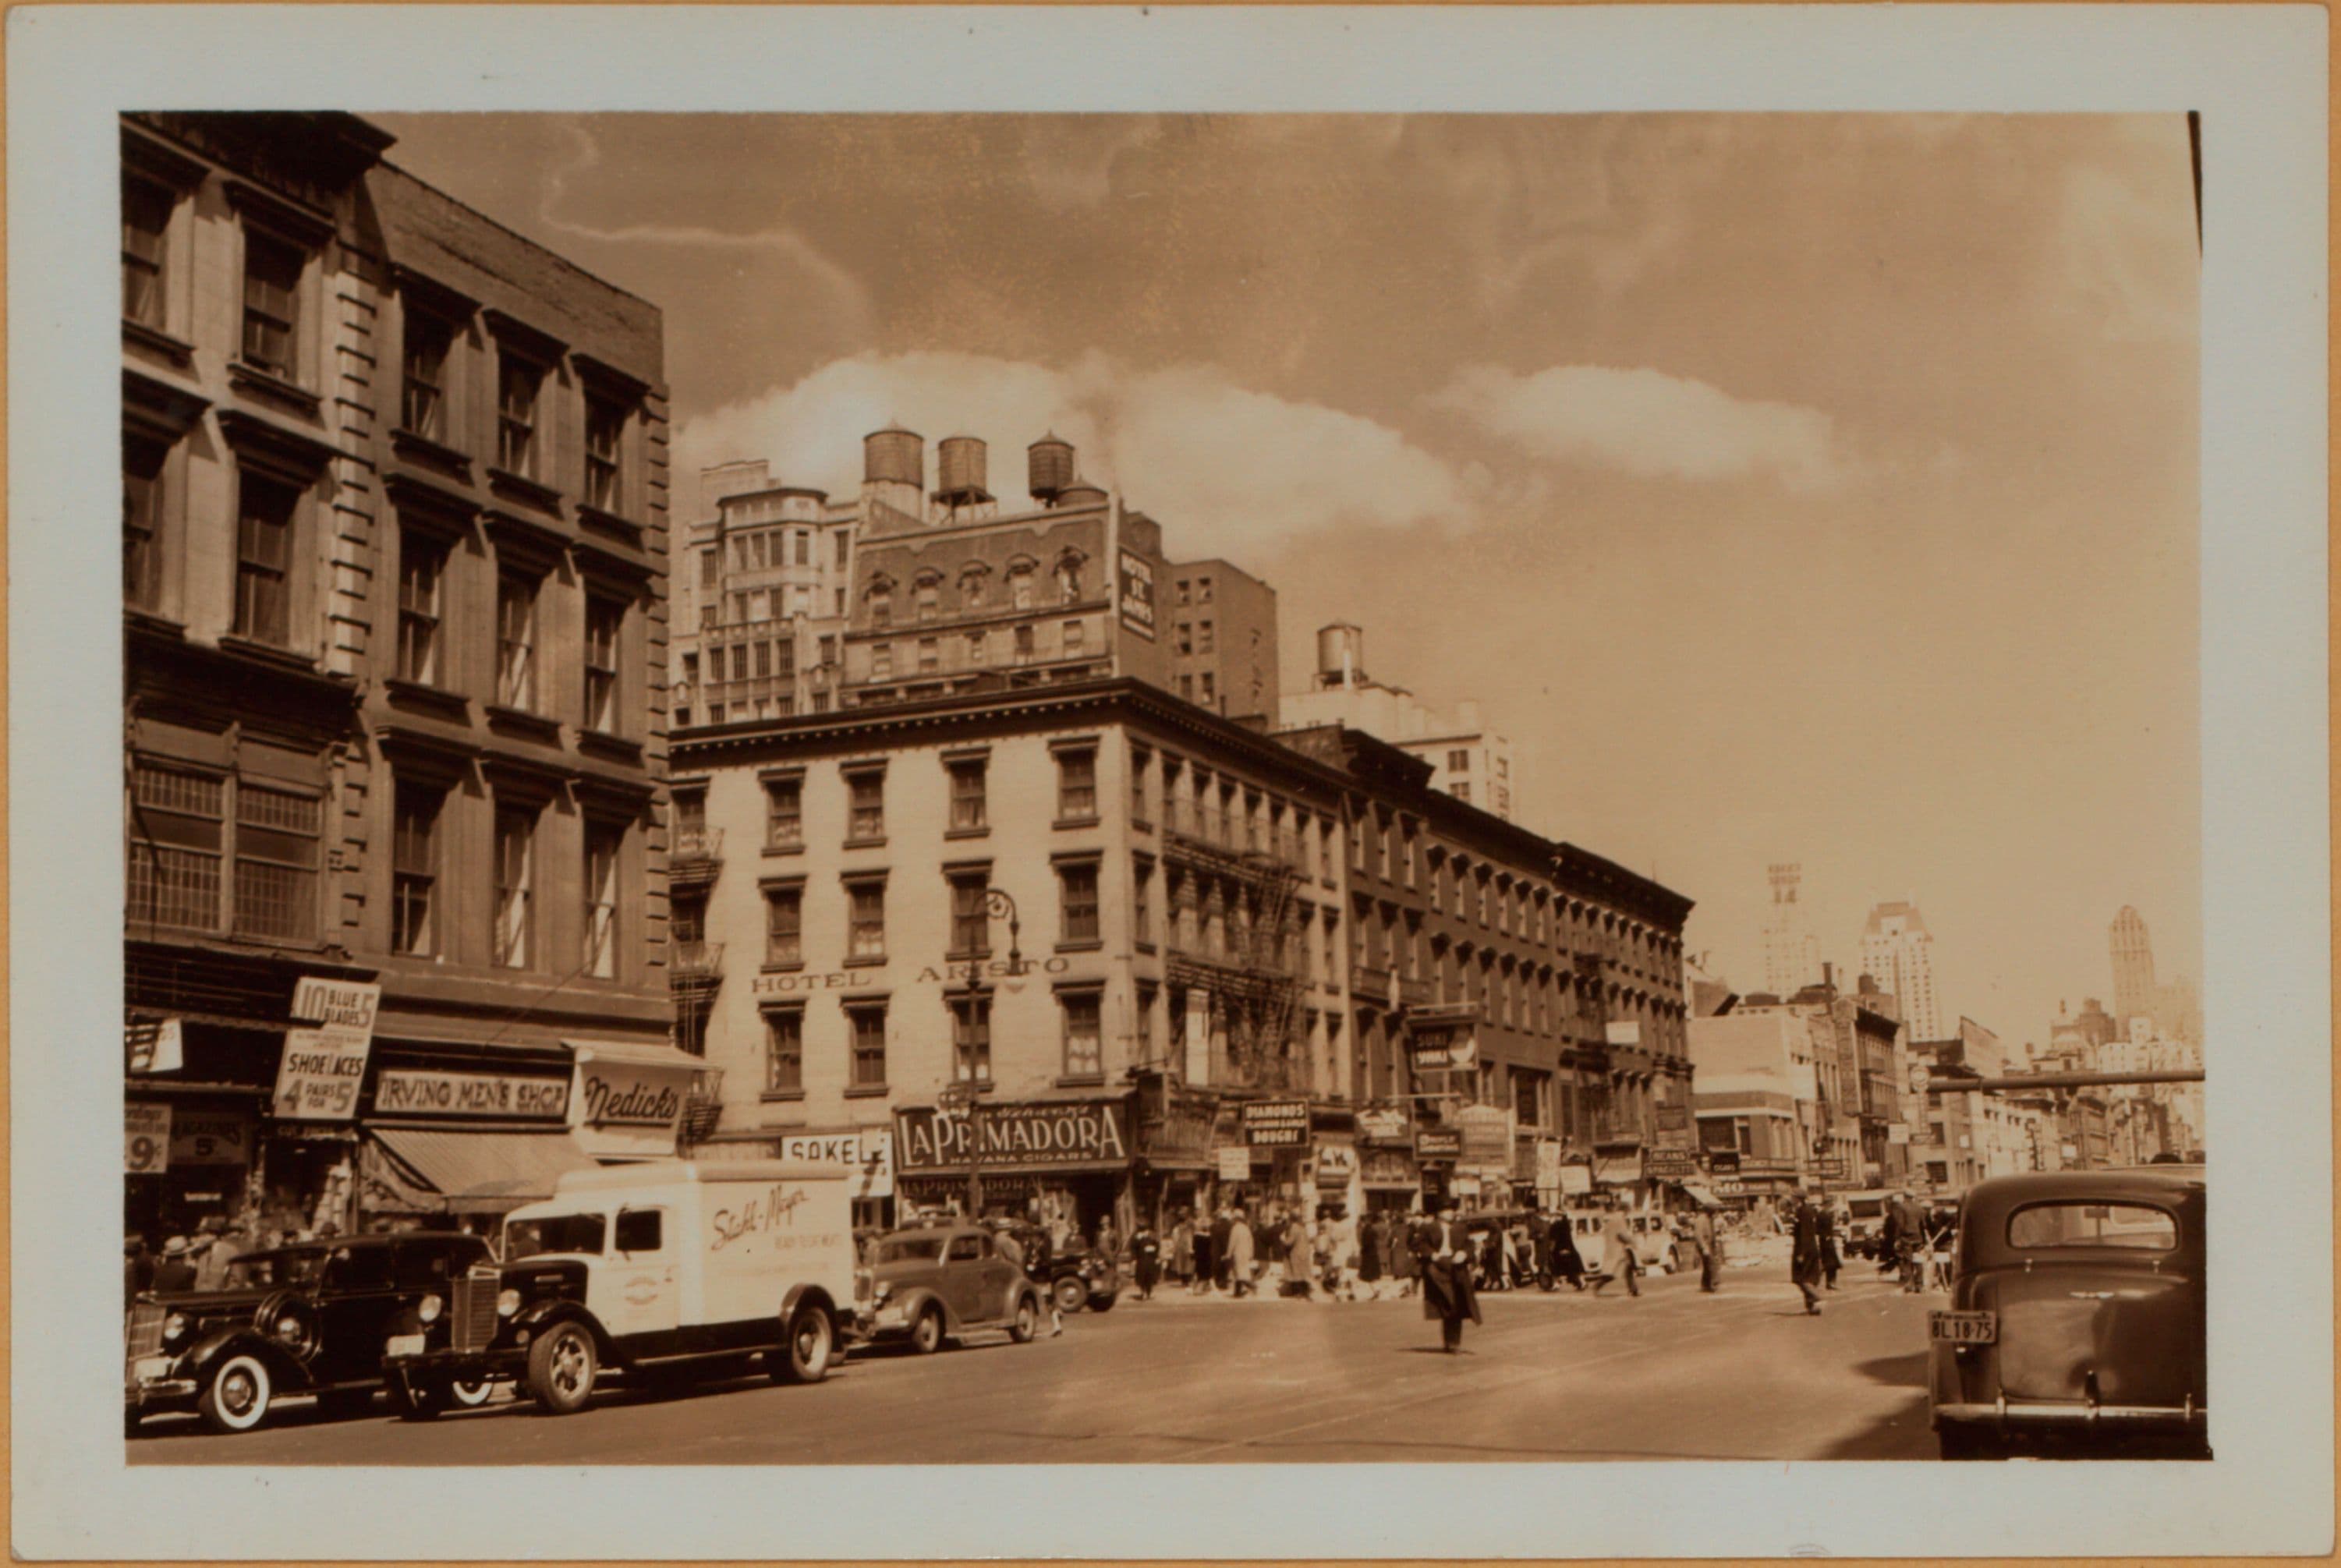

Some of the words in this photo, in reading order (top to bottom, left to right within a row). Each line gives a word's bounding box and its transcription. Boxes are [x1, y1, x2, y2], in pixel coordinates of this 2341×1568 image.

[328, 989, 358, 1008] BLUE
[751, 973, 873, 993] HOTEL
[283, 1079, 303, 1110] 4
[332, 1081, 353, 1112] 5
[381, 1078, 451, 1107] IRVING
[456, 1081, 511, 1110] MEN'S
[516, 1084, 564, 1110] SHOP
[584, 1076, 678, 1121] Nedick's
[129, 1136, 153, 1170] 9
[900, 1116, 933, 1166] LA
[1023, 1151, 1092, 1162] CIGARS
